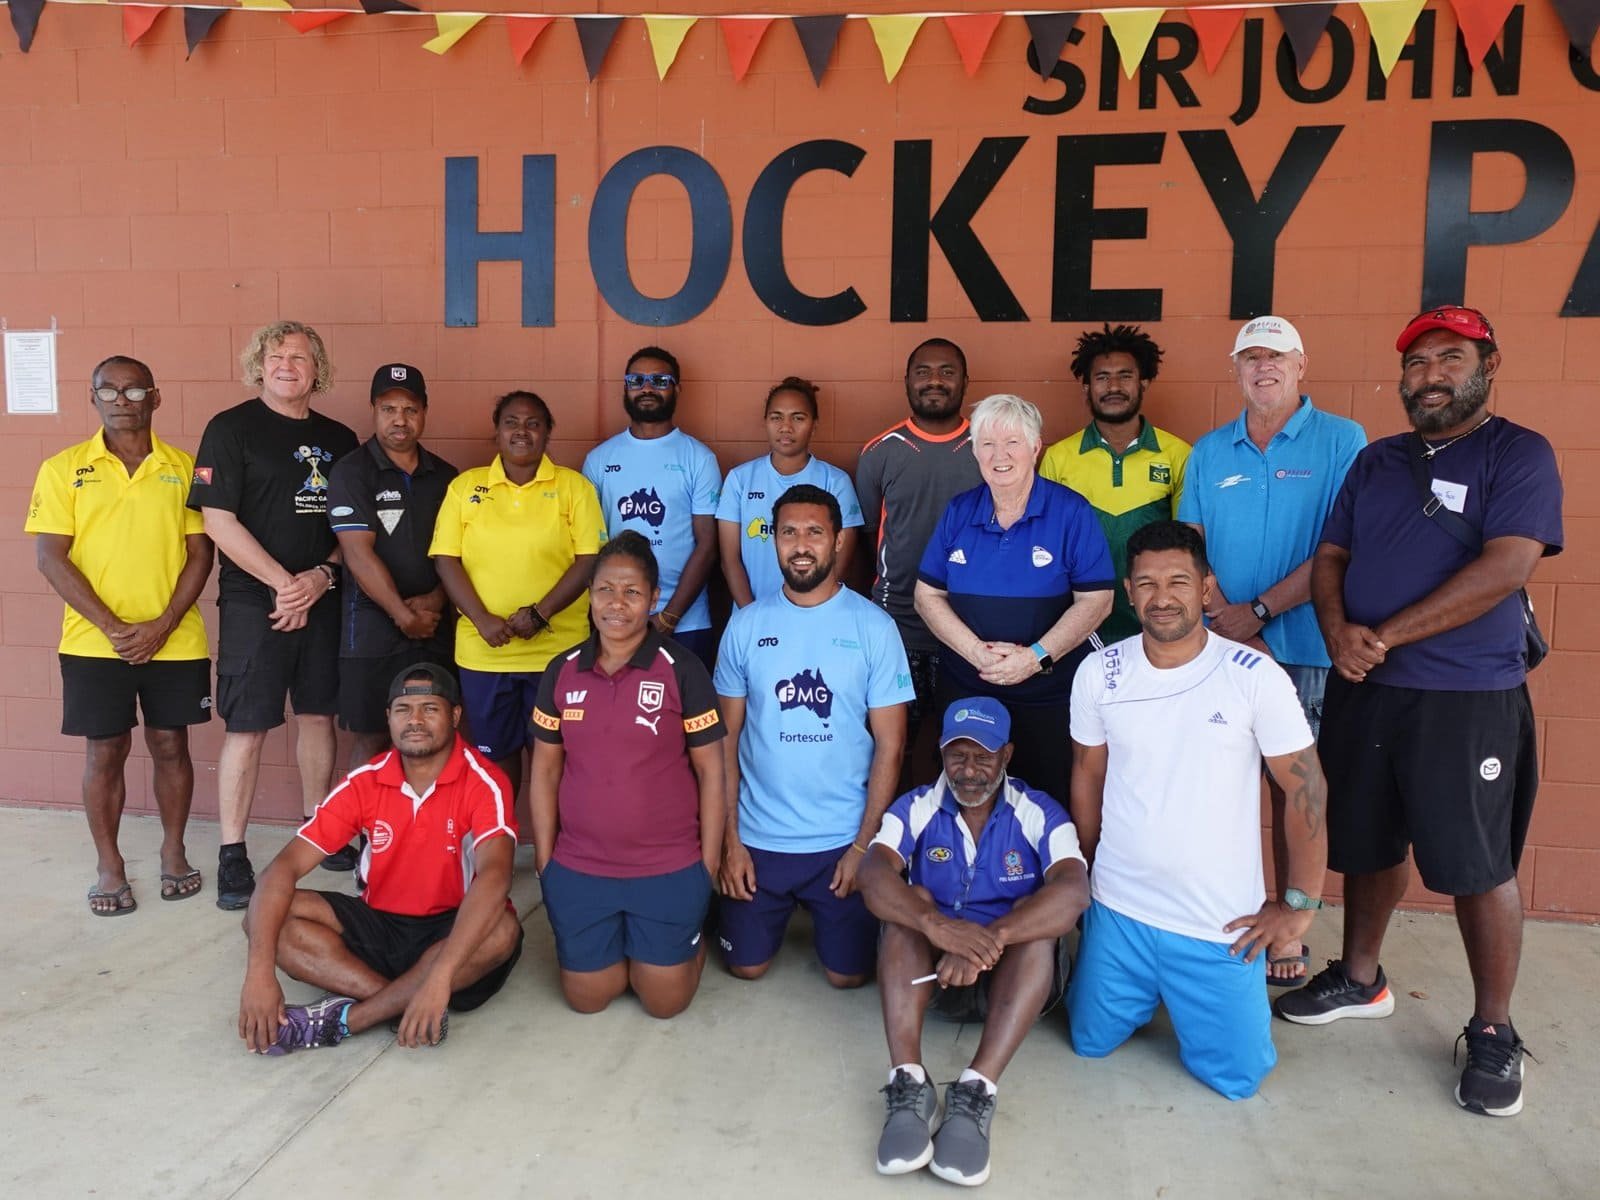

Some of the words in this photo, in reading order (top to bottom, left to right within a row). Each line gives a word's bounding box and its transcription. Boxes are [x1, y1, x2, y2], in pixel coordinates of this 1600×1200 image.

[1022, 20, 1202, 116] SIR
[1229, 4, 1525, 127] JOHN
[444, 123, 1346, 328] HOCKEY
[1152, 471, 1169, 481] SP
[621, 501, 662, 515] FMG
[757, 637, 779, 648] OTG
[779, 686, 828, 704] FMG
[686, 712, 718, 731] XXXX
[779, 731, 834, 743] Fortescue
